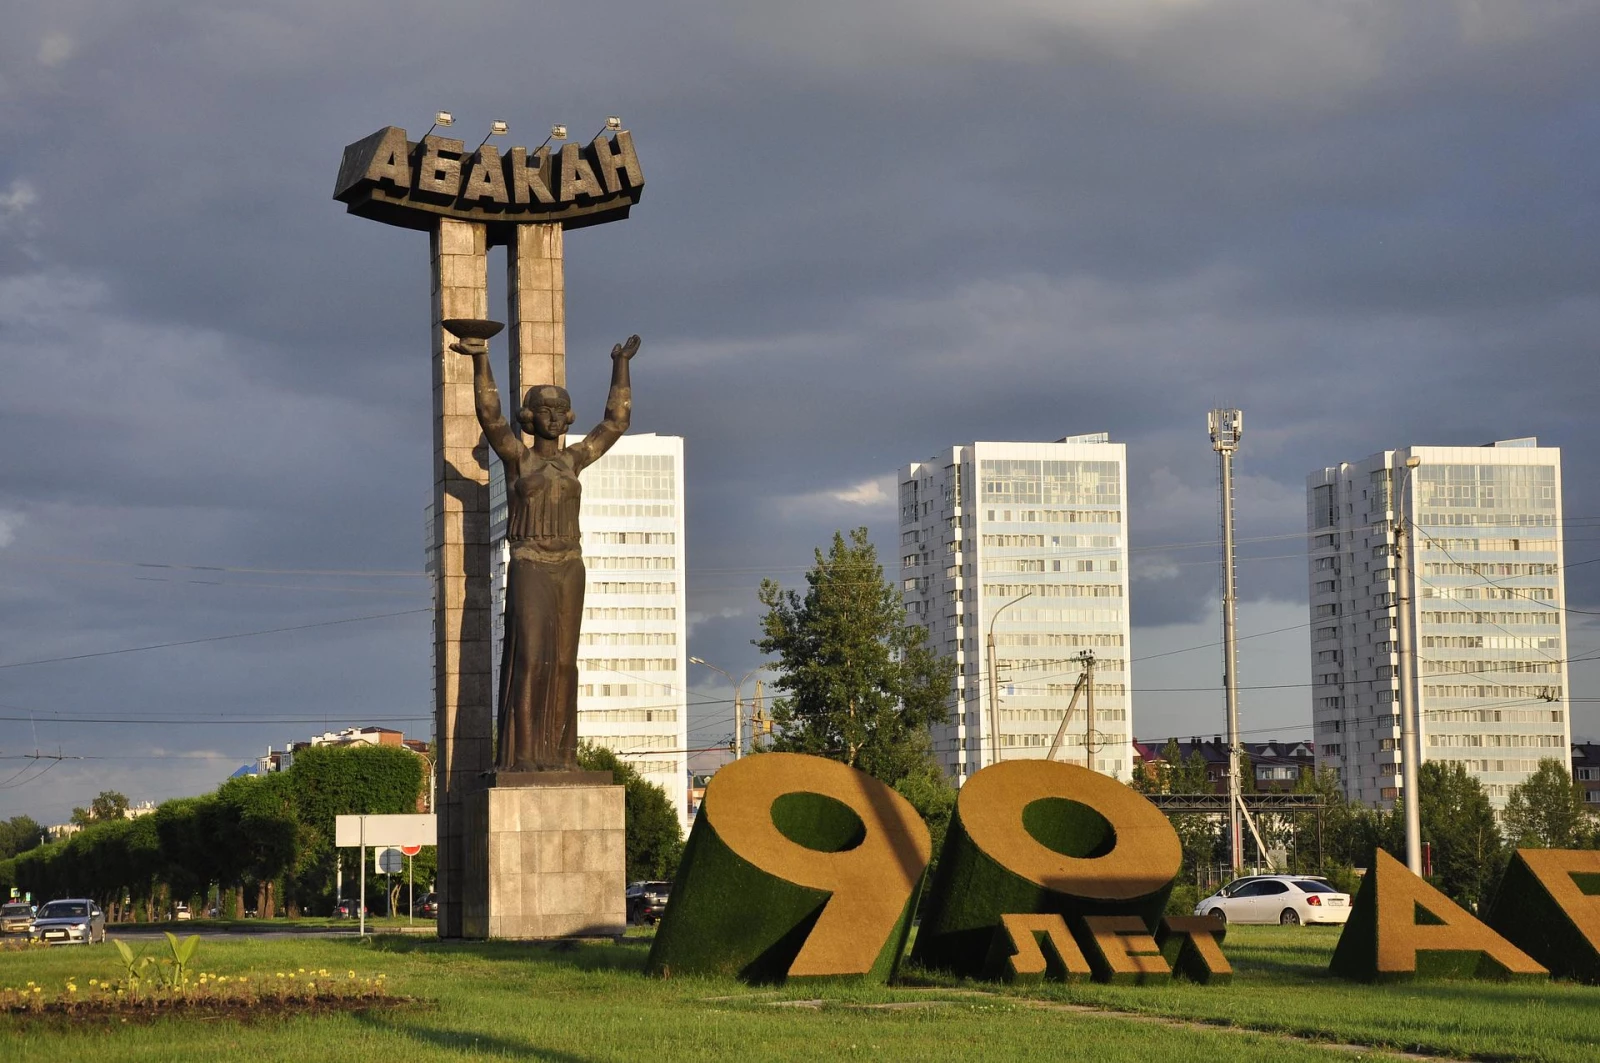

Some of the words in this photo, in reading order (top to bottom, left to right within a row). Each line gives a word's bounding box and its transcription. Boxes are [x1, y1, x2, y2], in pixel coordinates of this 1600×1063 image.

[365, 126, 645, 204] АБАКАН
[704, 752, 1182, 975] 90
[1001, 913, 1232, 974] ЛЕТ
